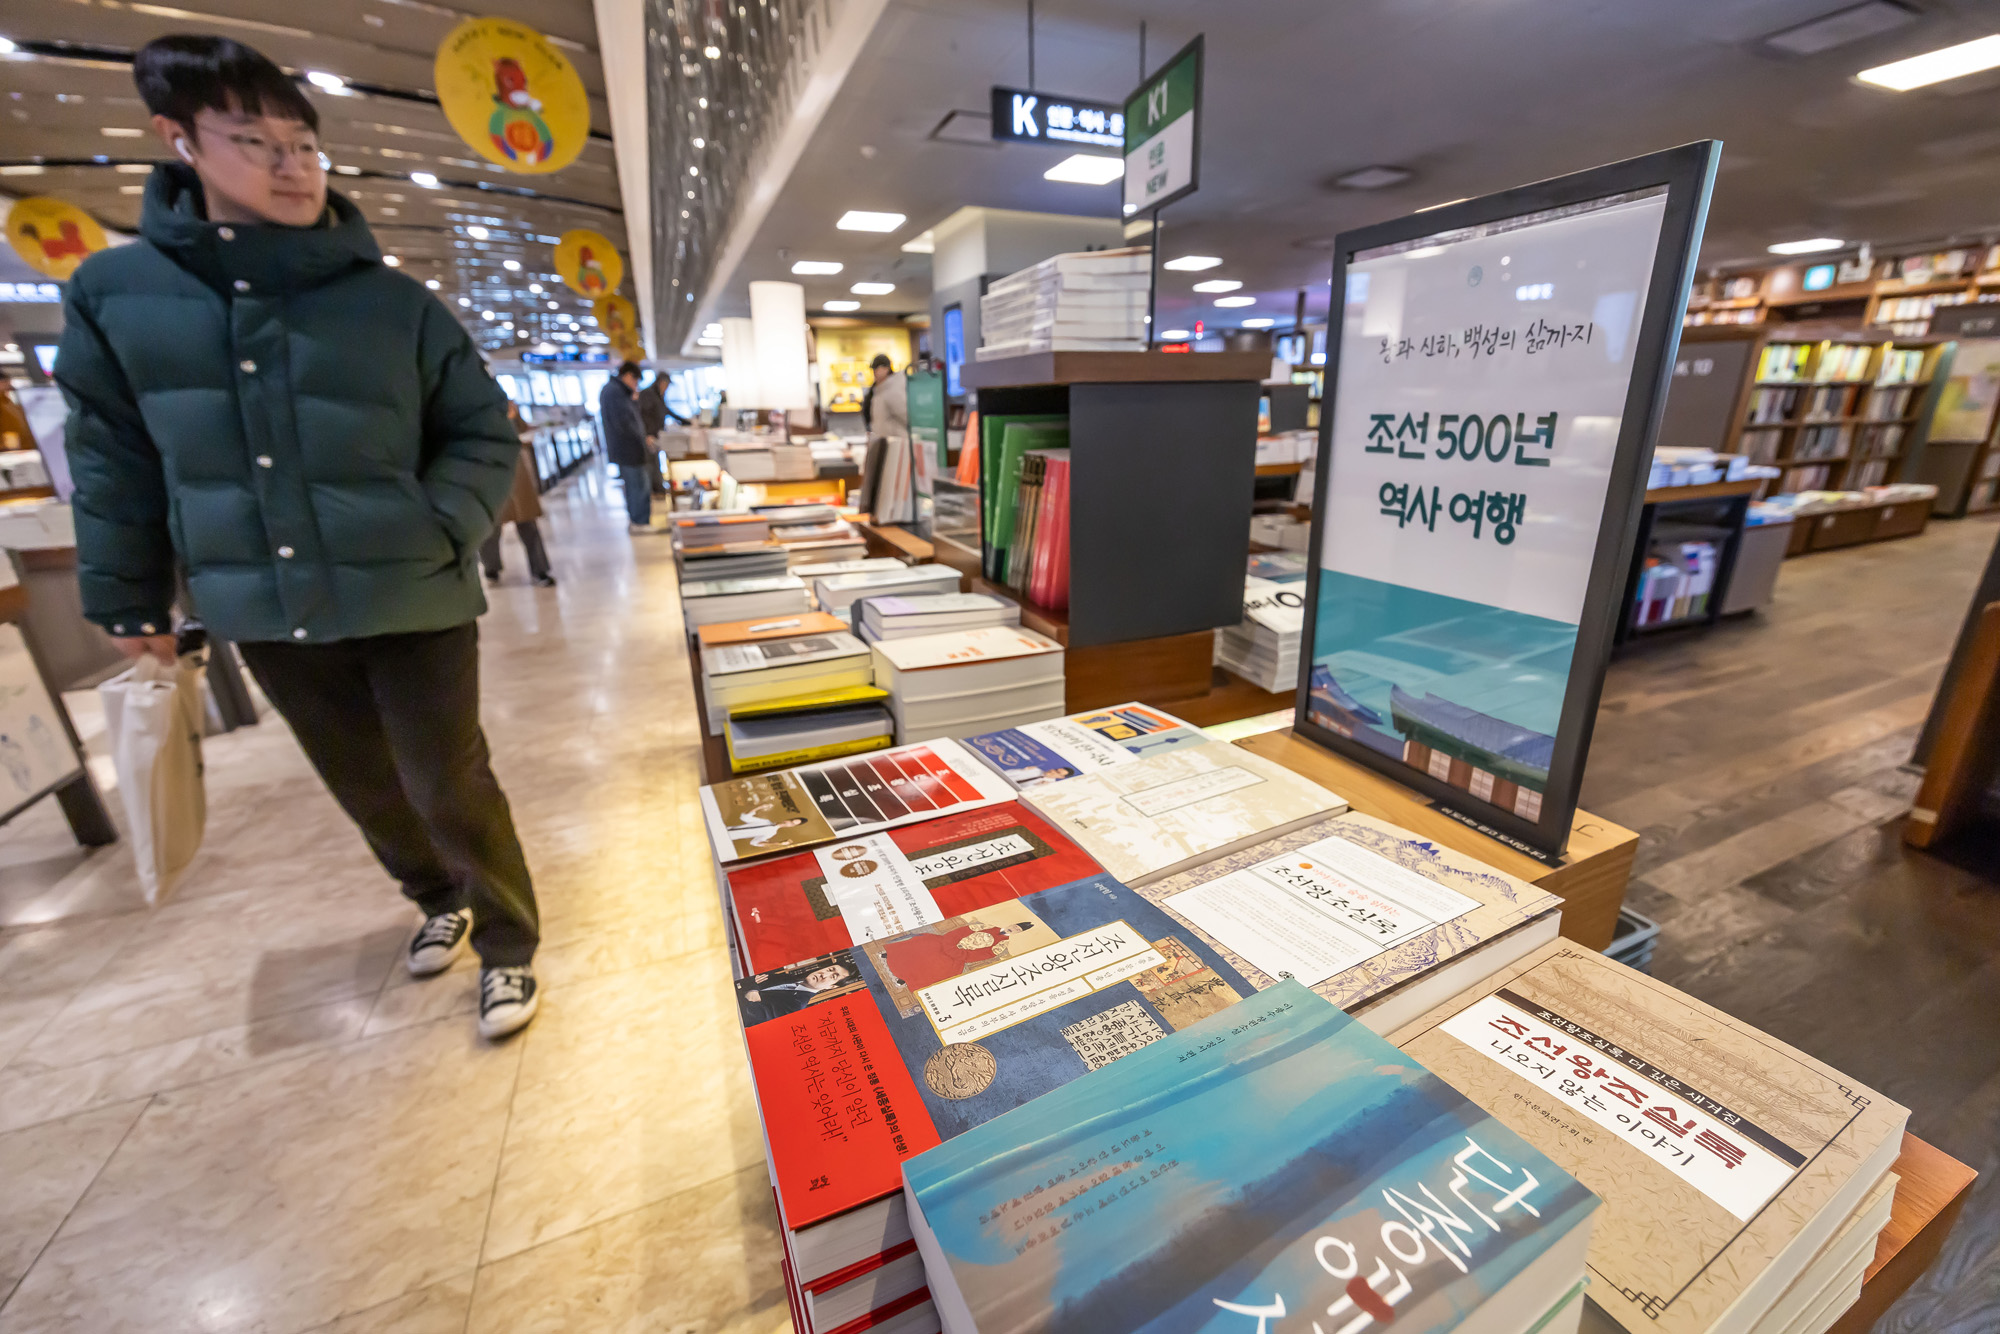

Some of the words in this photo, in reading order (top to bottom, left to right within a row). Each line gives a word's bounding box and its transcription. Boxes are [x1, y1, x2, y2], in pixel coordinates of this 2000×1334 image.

[1012, 93, 1040, 137] K
[1147, 80, 1168, 126] K1
[1379, 338, 1415, 364] 왕과
[1420, 334, 1460, 359] 신하,
[1463, 324, 1517, 360] 백성의
[1525, 318, 1593, 354] 삶까지
[1365, 412, 1429, 460] 조선
[1435, 411, 1558, 467] 500년
[1379, 481, 1442, 532] 역사
[1449, 490, 1526, 545] 여행
[1266, 864, 1398, 935] 조선왕조실록
[952, 933, 1127, 1007] 조선왕조실록
[840, 1005, 850, 1018] 우리
[937, 1013, 953, 1023] 3
[980, 1009, 1017, 1028] 사대부의
[1019, 998, 1046, 1013] 사랑한
[1266, 1003, 1294, 1018] 이광수
[790, 1023, 816, 1057] 조선의
[844, 1018, 859, 1034] 시대의
[851, 1033, 866, 1051] 사관이
[957, 1024, 977, 1037] 임금
[1231, 1015, 1267, 1036] 장편소설
[859, 1050, 871, 1065] 다시
[1199, 1036, 1226, 1053] 이정서
[800, 1055, 828, 1095] 역사는
[831, 1059, 862, 1098] 당신이
[863, 1064, 874, 1072] 쓴
[866, 1072, 881, 1086] 정통
[1536, 1010, 1624, 1058] 조선왕조실록
[1628, 1058, 1646, 1071] 더
[1649, 1068, 1682, 1091] 깊은
[1685, 1091, 1742, 1127] 새겨짐
[1488, 1014, 1747, 1170] 조선왕조실록
[1490, 1039, 1556, 1080] 나오지
[1558, 1079, 1608, 1113] 않는
[1616, 1113, 1696, 1166] 이야기
[845, 1097, 873, 1129] 알던
[1513, 1093, 1580, 1137] 한국문화연구회
[892, 1134, 909, 1156] 탄생!
[1213, 1136, 1542, 1334] 단종애
